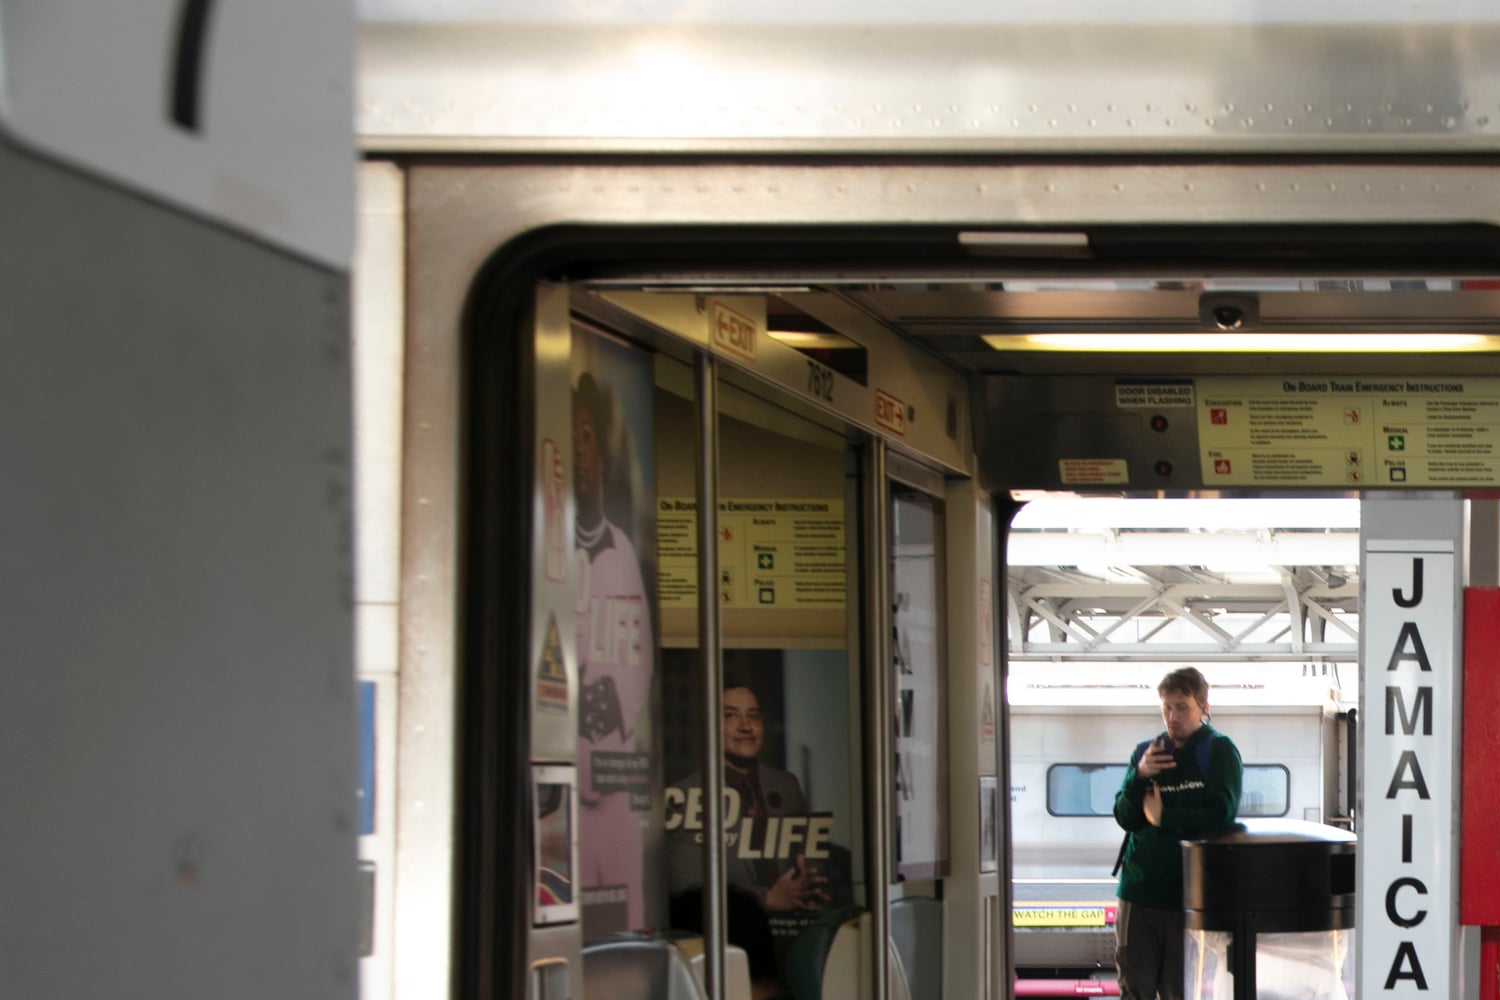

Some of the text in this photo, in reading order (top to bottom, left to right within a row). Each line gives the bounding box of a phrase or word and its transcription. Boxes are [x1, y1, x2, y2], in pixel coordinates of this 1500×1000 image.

[806, 359, 834, 403] 7612
[1329, 380, 1354, 393] TRAIN
[1355, 380, 1404, 393] EMERGENCY
[1406, 380, 1464, 393] INSTRUCTIONS
[1118, 387, 1191, 396] DOOR DISABLED
[1119, 396, 1192, 405] WHEN FLASHING
[1384, 557, 1434, 990] JAMAICA
[737, 816, 833, 859] LIFE
[1013, 910, 1054, 919] WATCH
[1057, 910, 1078, 919] THE
[1081, 910, 1104, 919] GAP
